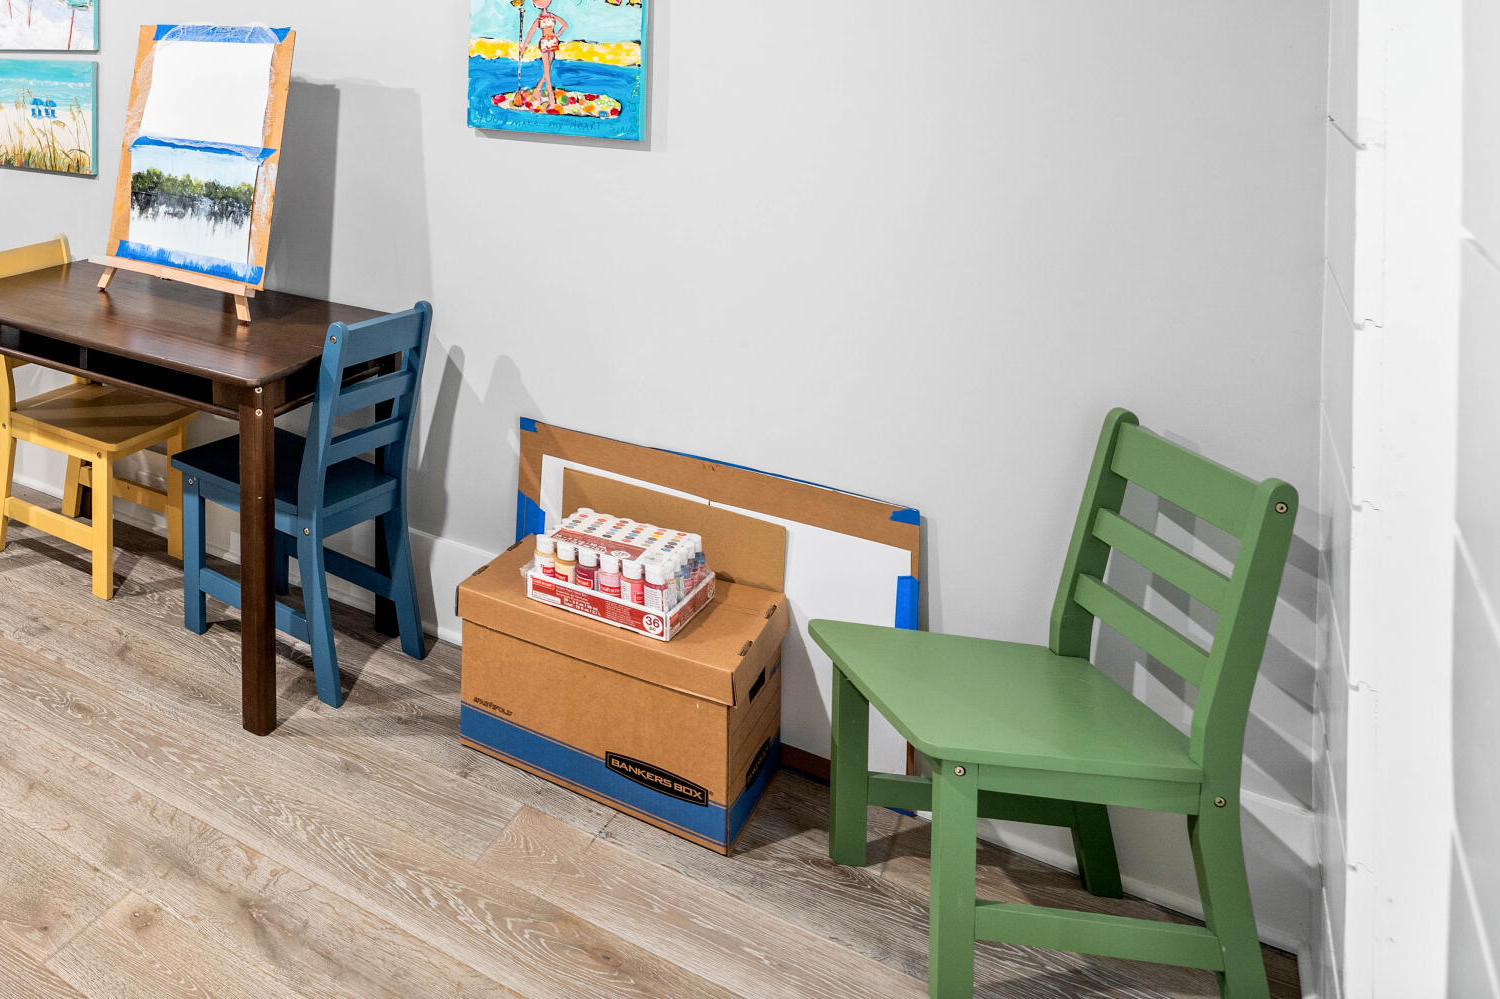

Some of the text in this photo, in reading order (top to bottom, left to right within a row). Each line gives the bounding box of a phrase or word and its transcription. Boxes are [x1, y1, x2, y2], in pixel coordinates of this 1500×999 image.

[645, 615, 660, 629] 36
[611, 757, 703, 801] BANKERS BOX
